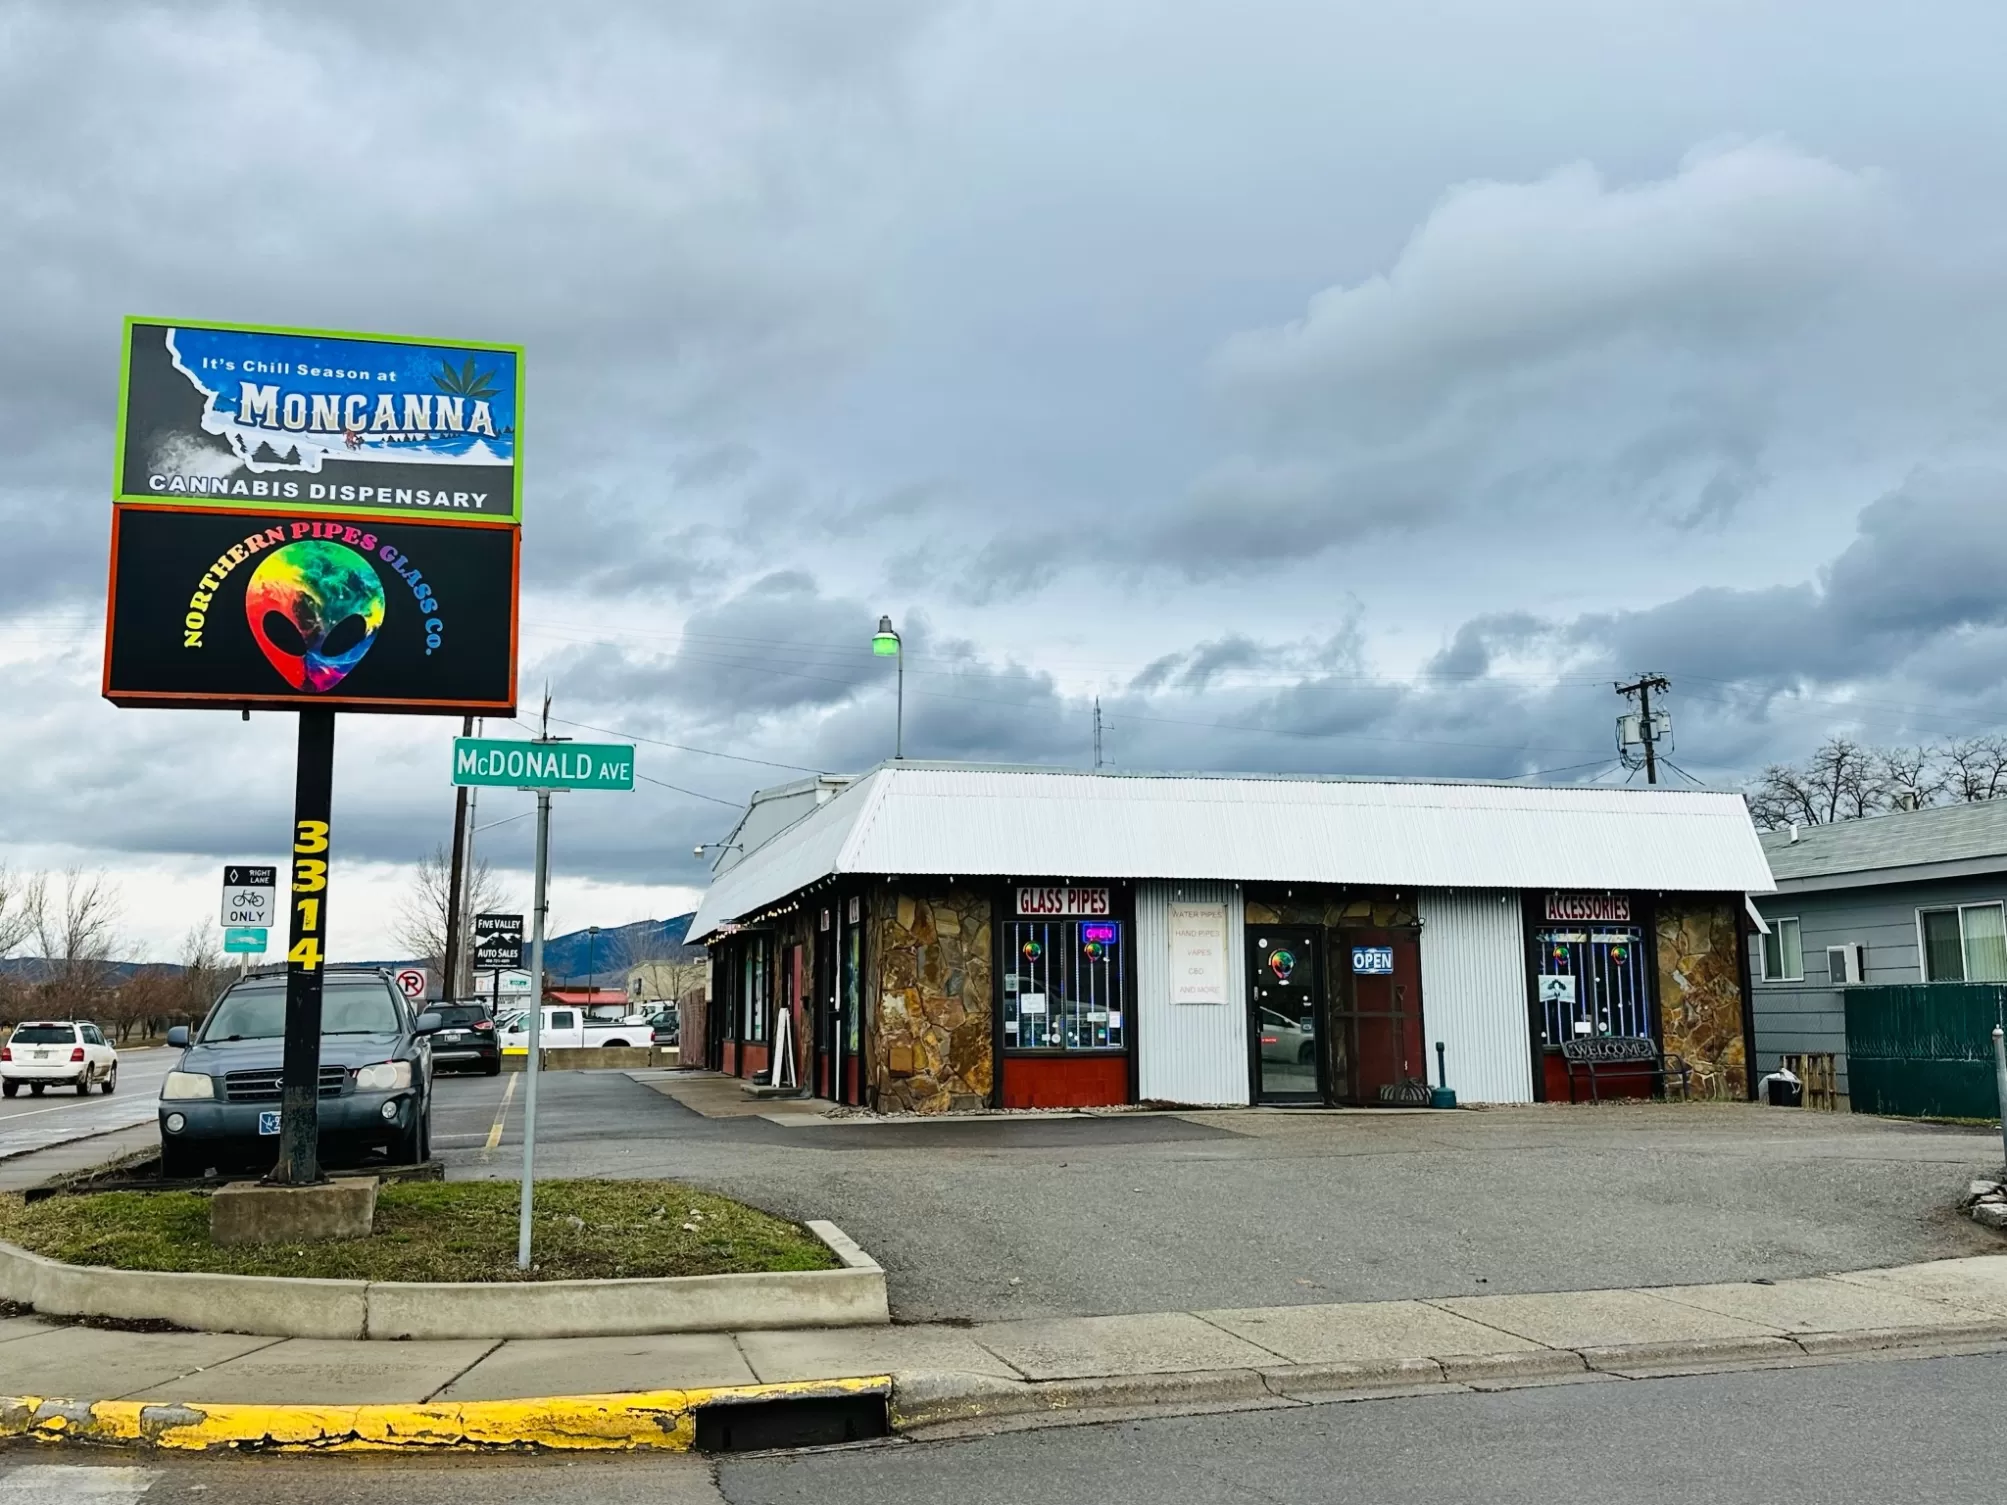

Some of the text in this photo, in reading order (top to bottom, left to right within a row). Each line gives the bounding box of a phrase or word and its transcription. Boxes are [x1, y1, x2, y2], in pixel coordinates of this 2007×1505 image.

[202, 357, 397, 382] It's Chill Season at
[237, 381, 496, 438] MONCANNA
[148, 474, 488, 509] CANNABIS DISPENSARY
[184, 526, 287, 649] NORTHERN
[290, 522, 378, 551] PIPES
[379, 545, 439, 614] GLASS
[457, 748, 630, 781] McDONALD AVE
[249, 869, 271, 877] RIGHT
[288, 820, 329, 971] 3314
[1020, 888, 1107, 914] GLASS PIPES
[1172, 910, 1223, 919] WATER PIPES
[1549, 896, 1629, 920] ACCESSORIES
[230, 911, 265, 922] ONLY
[478, 919, 521, 929] FIVE VALLEY
[1086, 928, 1113, 940] OPEN
[1175, 930, 1220, 938] HAND PIPES
[477, 948, 519, 958] AUTO SALES
[1187, 948, 1213, 957] VAPES
[1353, 952, 1393, 969] OPEN
[1179, 986, 1221, 994] AND MORE
